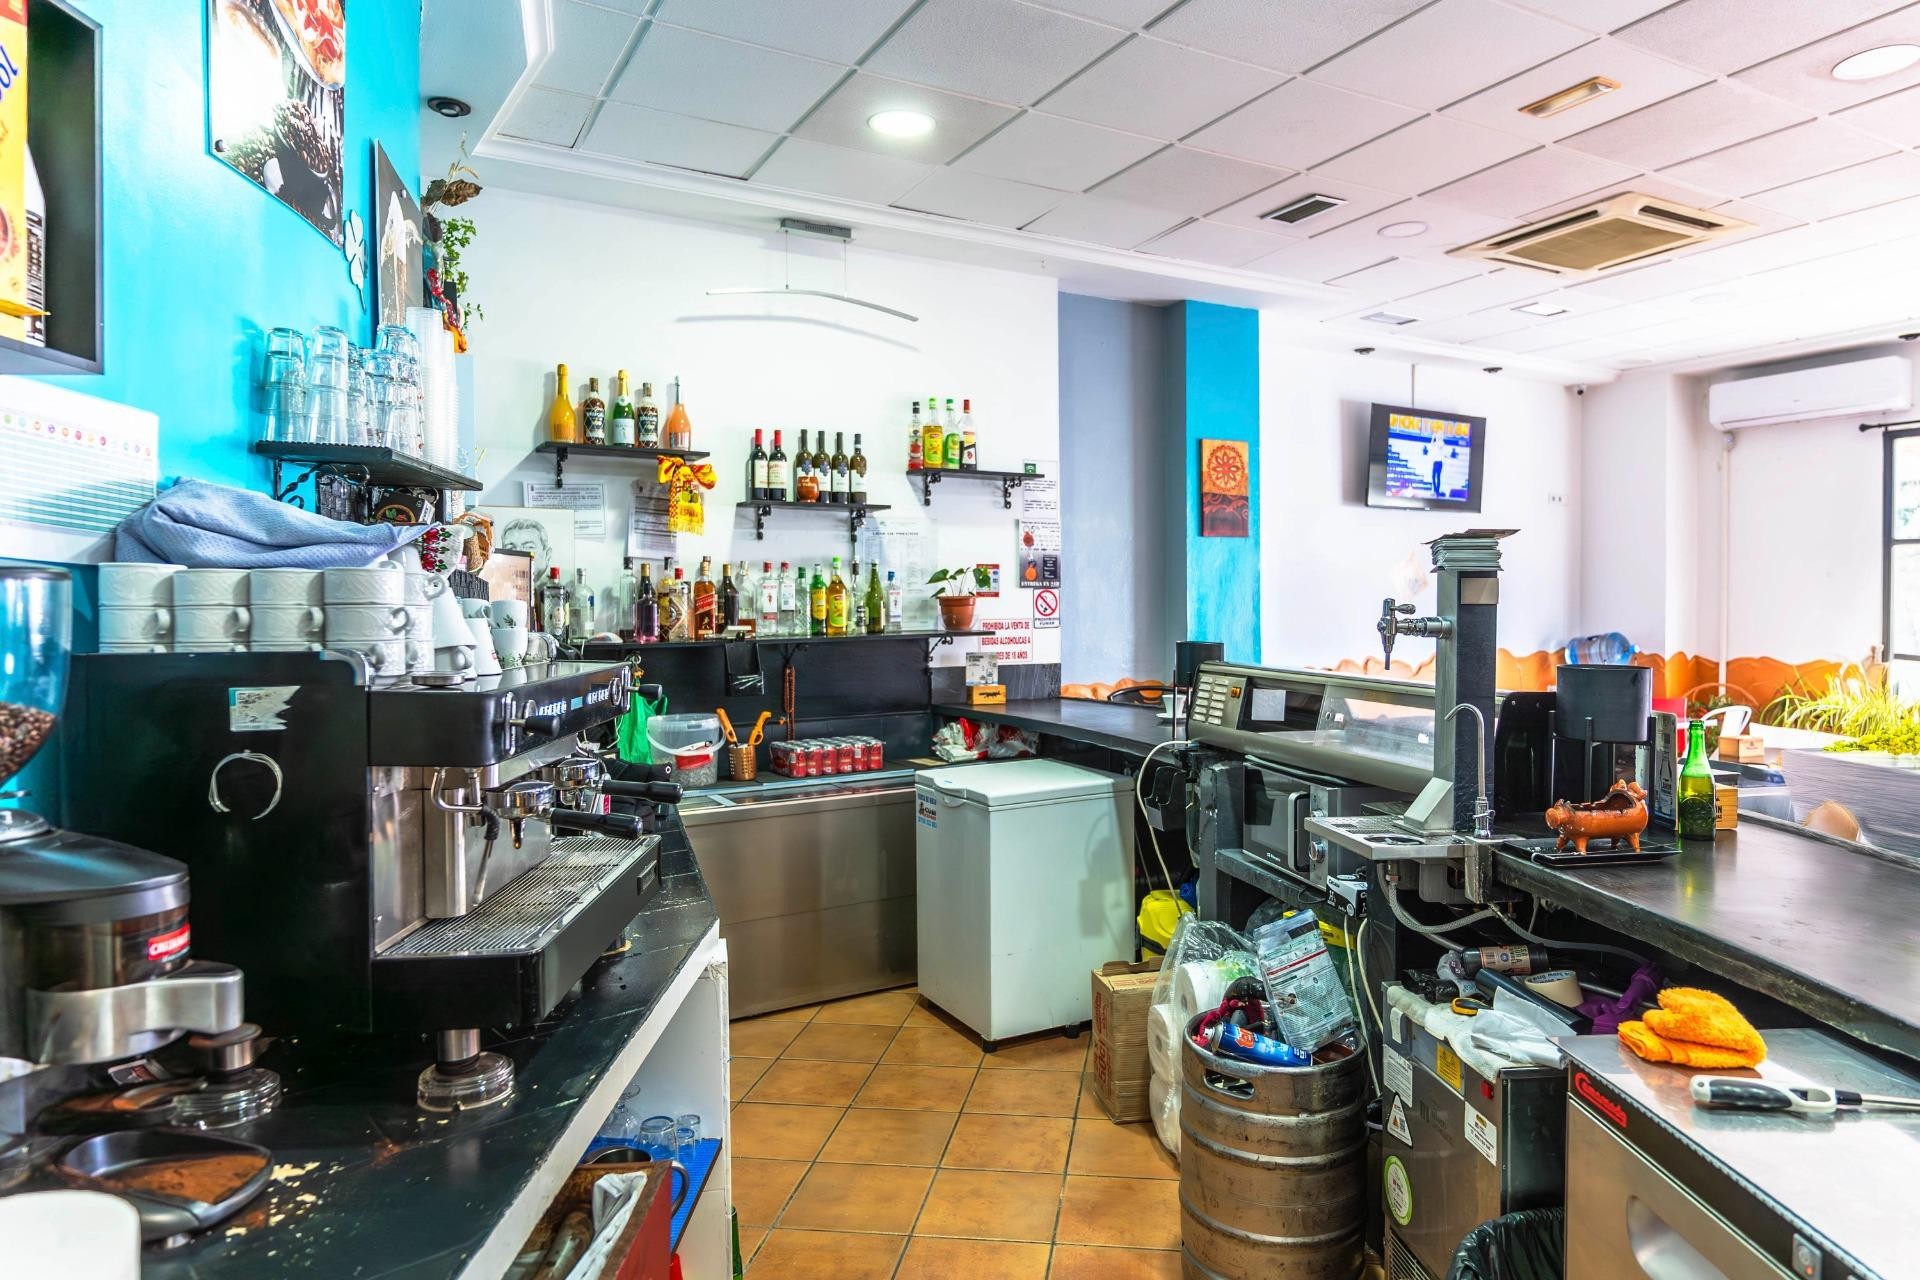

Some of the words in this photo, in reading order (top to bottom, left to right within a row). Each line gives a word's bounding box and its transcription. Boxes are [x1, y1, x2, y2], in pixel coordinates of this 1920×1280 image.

[982, 622, 1004, 630] PROHIBIDA
[1005, 622, 1010, 630] LA
[1011, 621, 1024, 630] VENTA
[1025, 621, 1030, 629] DE
[981, 637, 999, 646] BEBIDAS
[1005, 652, 1011, 660] DE
